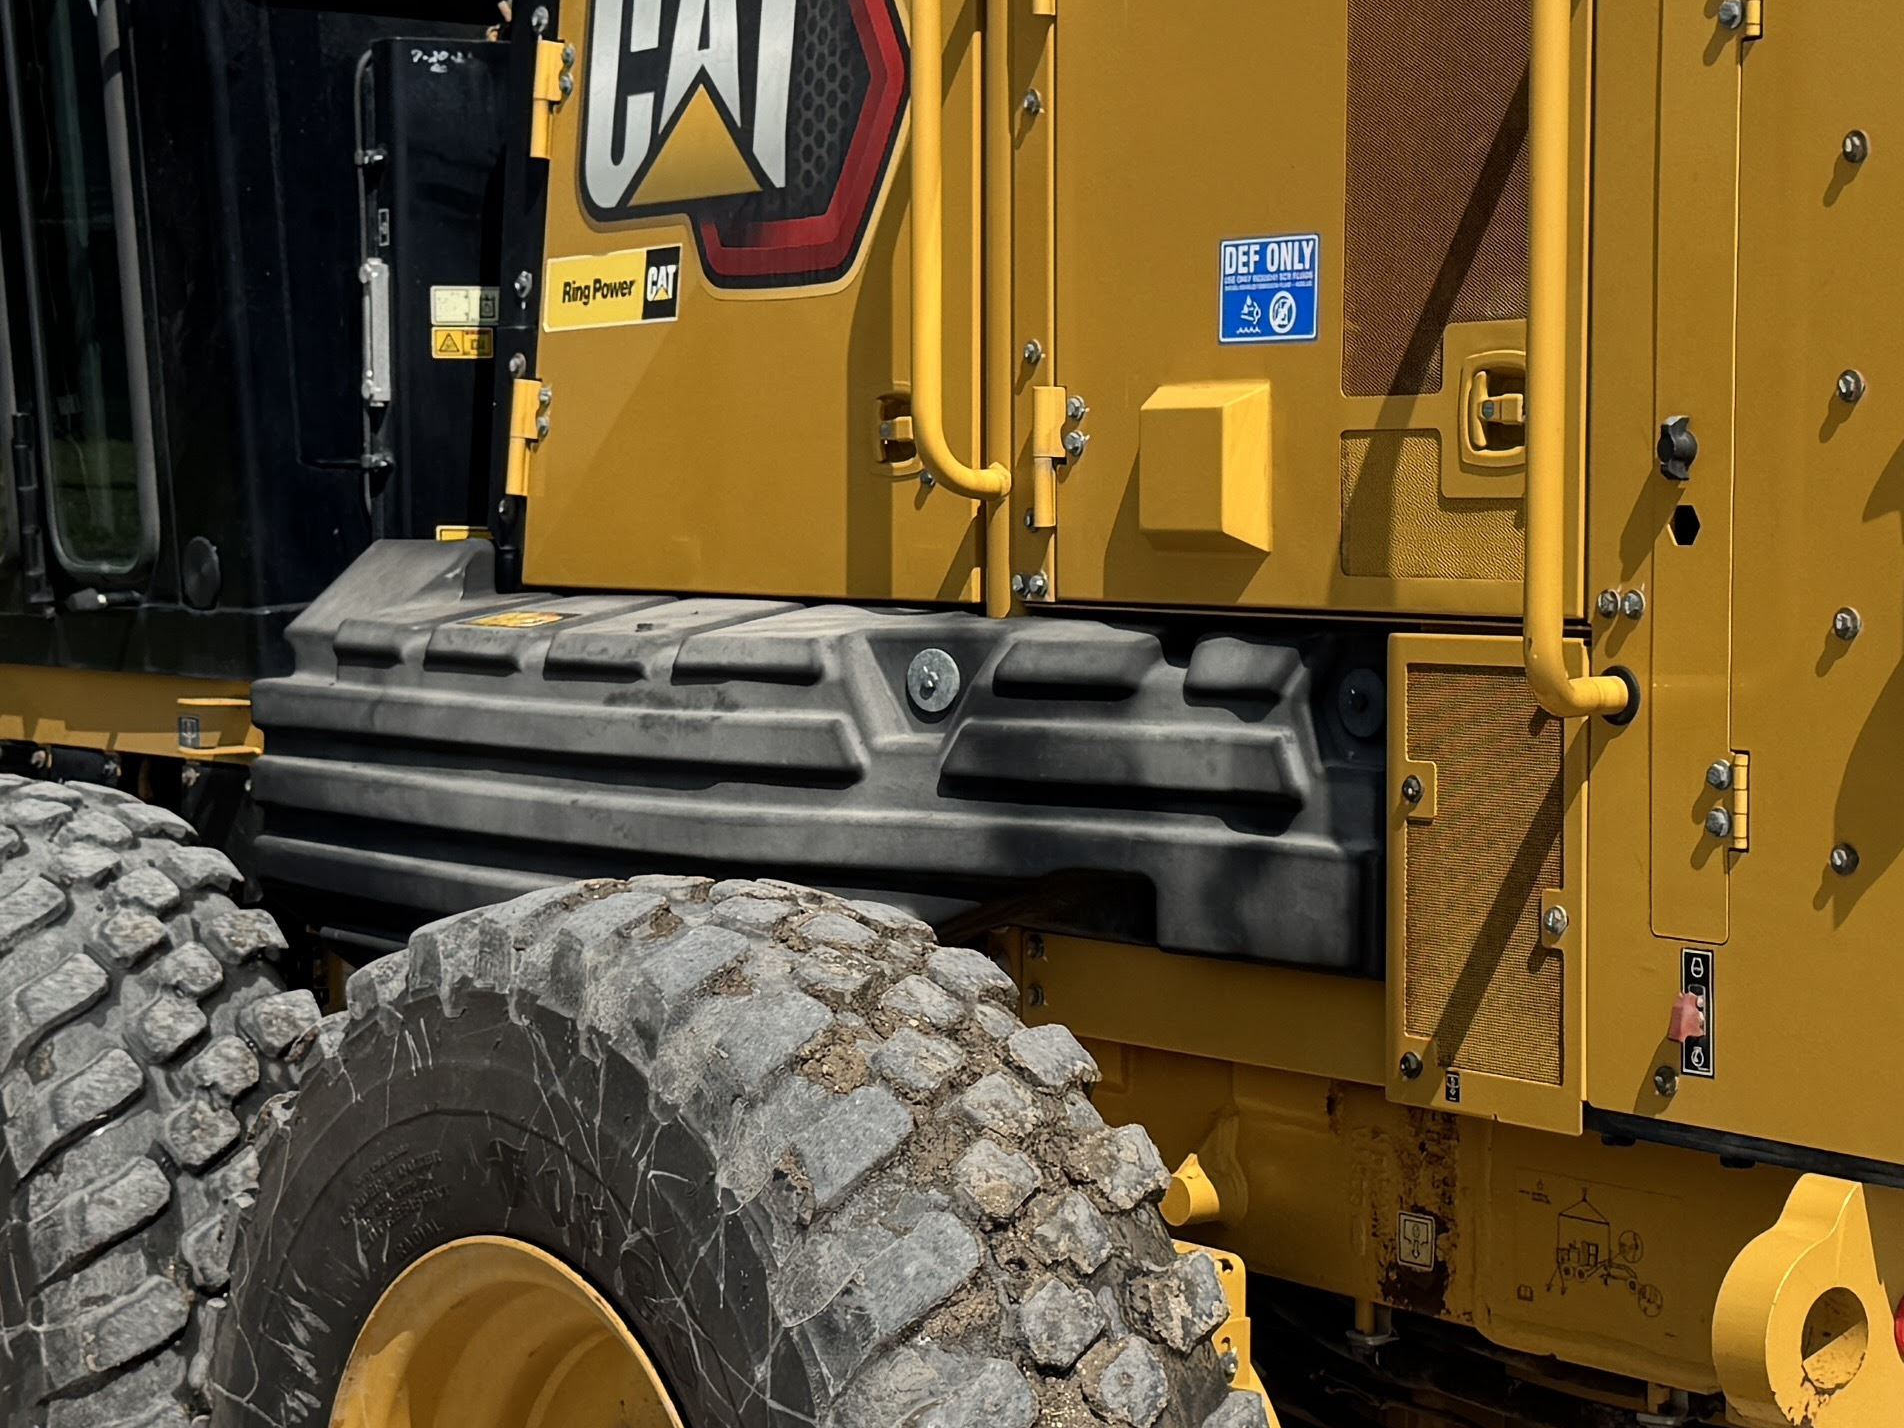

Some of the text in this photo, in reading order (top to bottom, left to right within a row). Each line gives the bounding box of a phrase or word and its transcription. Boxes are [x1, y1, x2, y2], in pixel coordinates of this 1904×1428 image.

[1225, 240, 1314, 275] DEF ONLY
[562, 278, 635, 306] Ring Power
[646, 265, 678, 301] CAT
